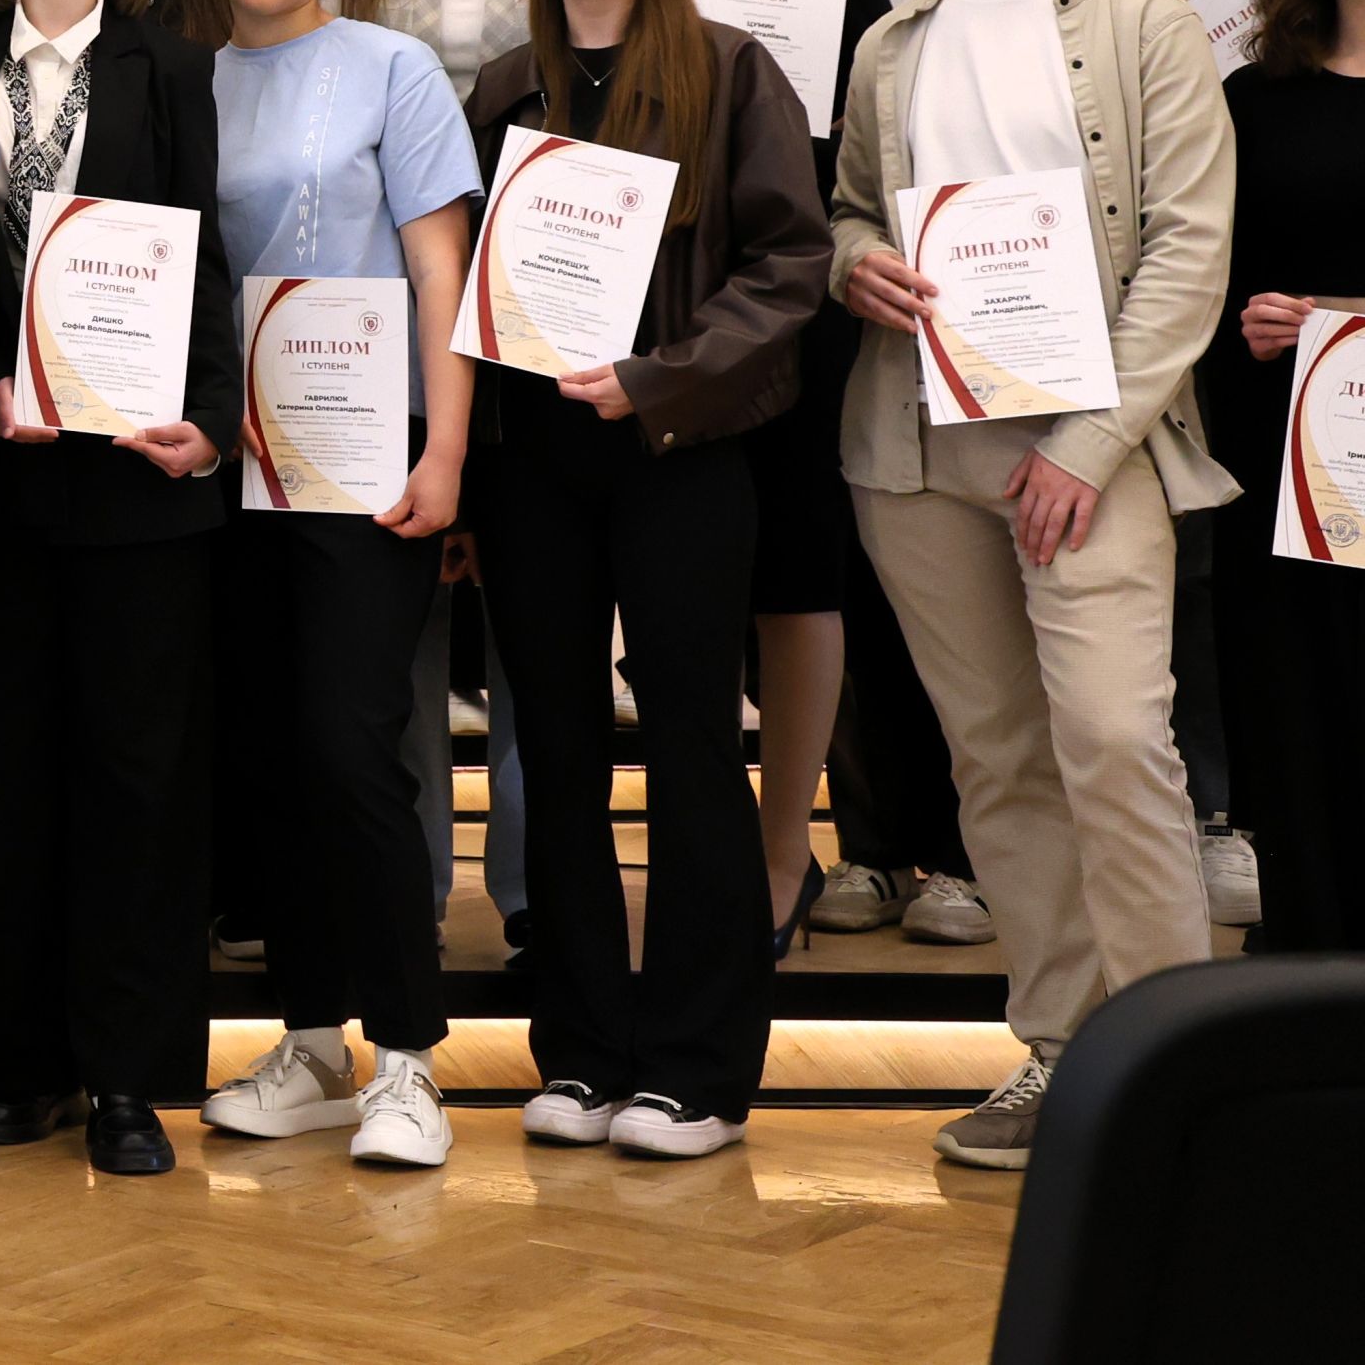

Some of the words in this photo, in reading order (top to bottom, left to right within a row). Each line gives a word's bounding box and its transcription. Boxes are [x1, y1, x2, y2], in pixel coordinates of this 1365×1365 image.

[302, 114, 320, 158] FAR
[528, 195, 623, 229] ДИПЛОМ
[296, 183, 310, 262] AWAY
[555, 223, 599, 240] СТУПЕНЯ
[949, 236, 1050, 263] ДИПЛОМ
[65, 258, 157, 281] ДИПЛОМ
[521, 260, 555, 273] Юліанна
[539, 254, 589, 271] КОЧЕРЕЩУК
[980, 261, 1029, 273] СТУПЕНЯ
[91, 283, 135, 294] СТУПЕНЯ
[62, 322, 85, 330] Софія
[92, 316, 123, 325] ДИШКО
[281, 340, 370, 355] ДИПЛОМ
[307, 362, 350, 370] СТУПЕНЯ
[277, 404, 313, 412] Катерина
